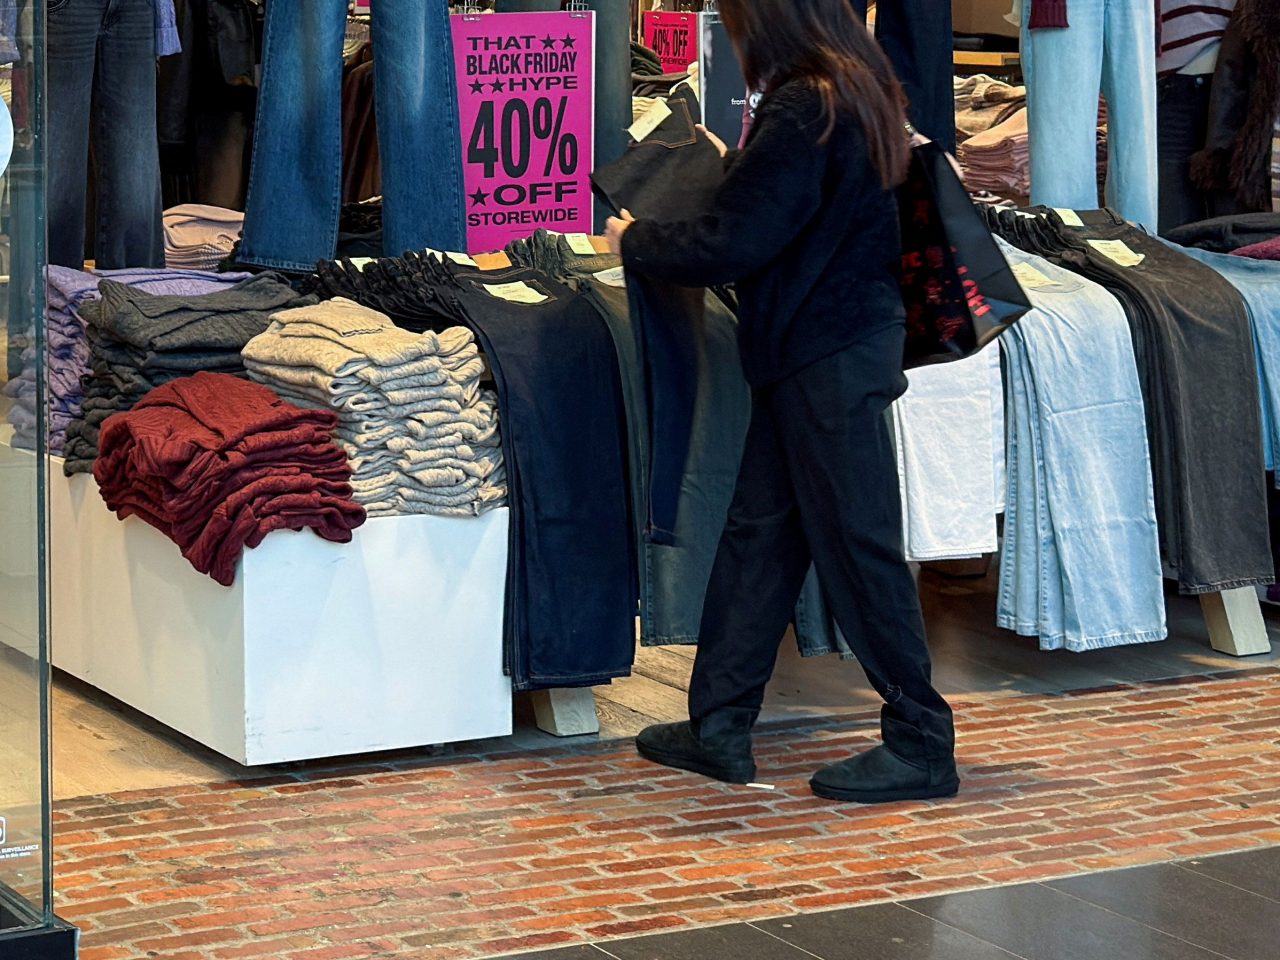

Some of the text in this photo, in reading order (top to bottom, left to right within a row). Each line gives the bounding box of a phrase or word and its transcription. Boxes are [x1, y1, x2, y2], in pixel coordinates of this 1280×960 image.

[466, 36, 536, 51] THAT
[652, 28, 688, 57] 40% OFF
[466, 51, 577, 75] BLACK FRIDAY
[659, 57, 688, 65] OREWIDE
[509, 75, 577, 91] HYPE
[467, 96, 578, 178] 40%
[493, 181, 578, 206] OFF
[467, 208, 578, 227] STOREWIDE
